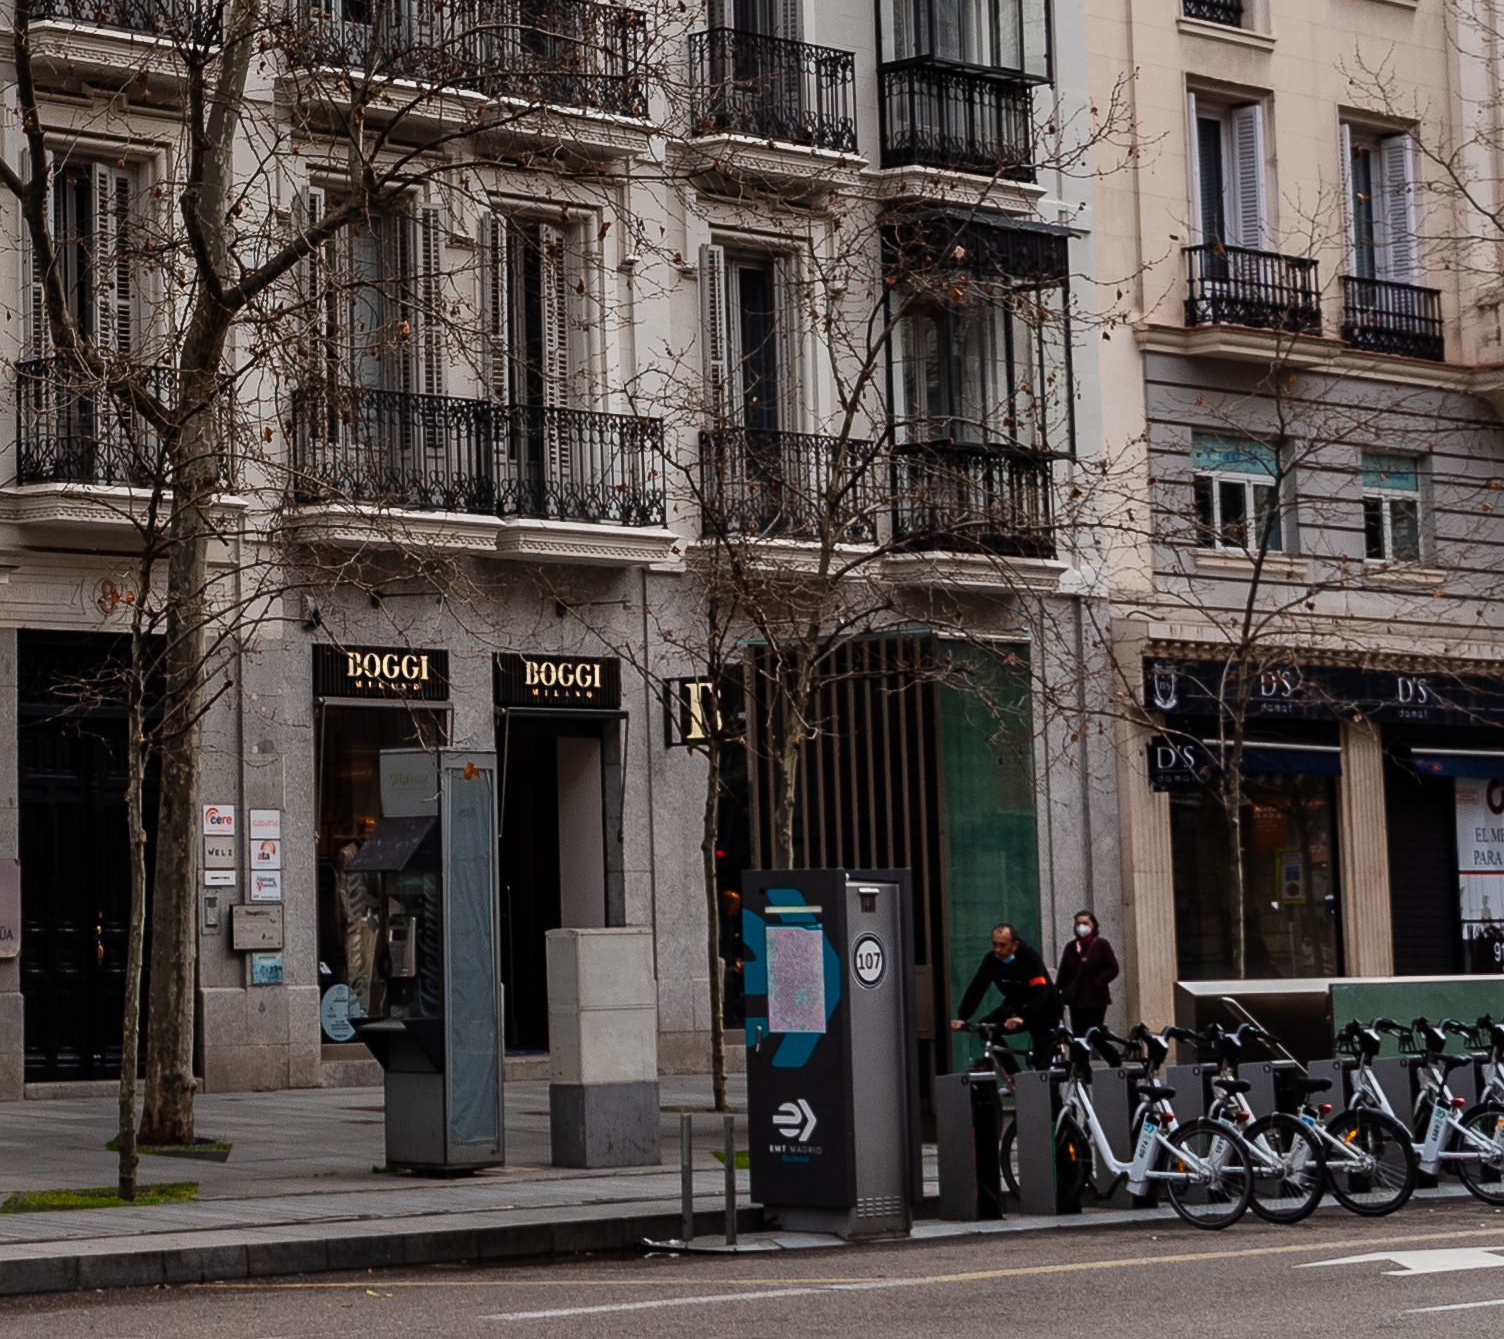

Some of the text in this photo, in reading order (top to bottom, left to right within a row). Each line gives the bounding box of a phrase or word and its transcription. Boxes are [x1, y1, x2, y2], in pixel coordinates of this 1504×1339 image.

[347, 652, 428, 680] BOGGI
[525, 661, 601, 687] BOGGI
[532, 688, 592, 699] MILANO
[1398, 677, 1428, 703] D'S
[1157, 745, 1195, 769] D'S
[1475, 827, 1489, 843] EL
[1473, 850, 1502, 865] PARA
[858, 953, 881, 970] 107
